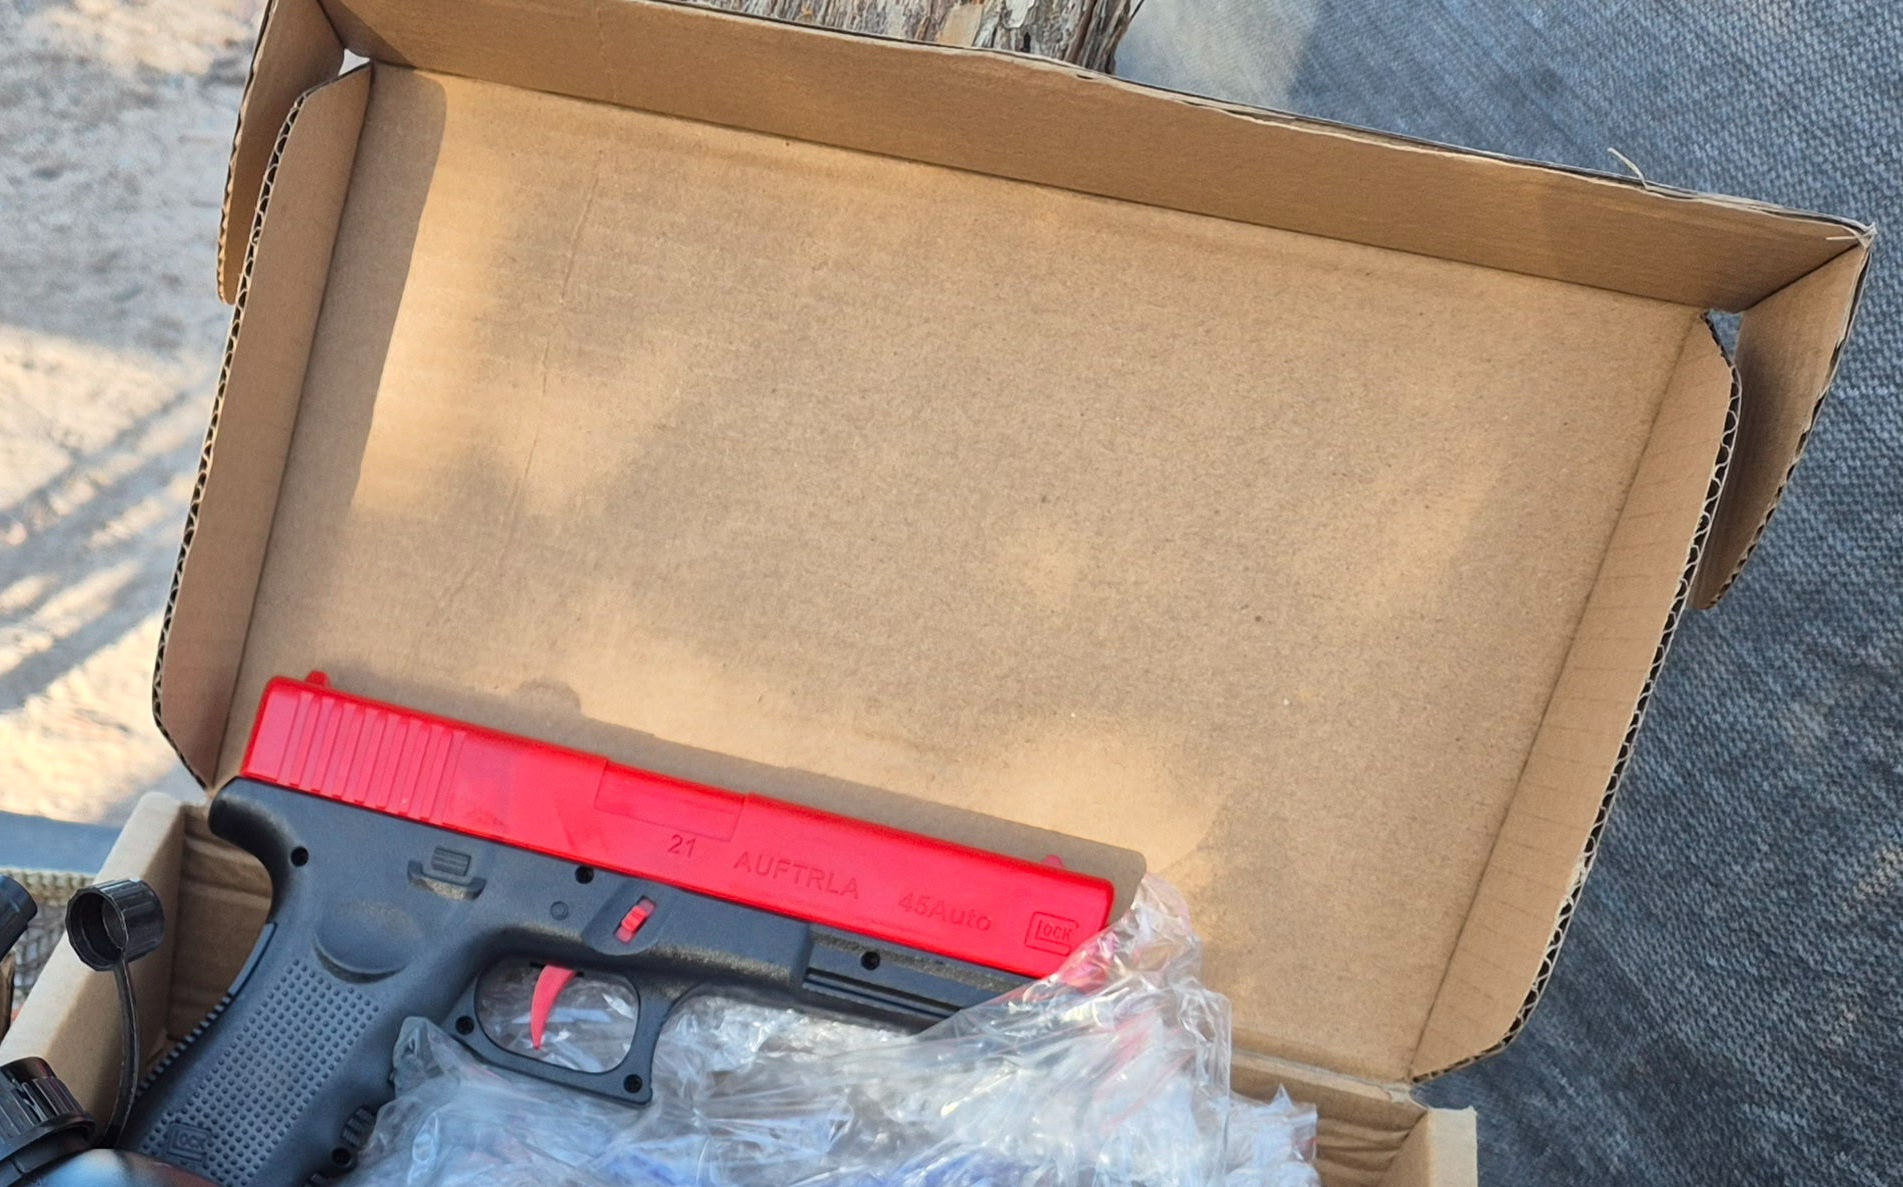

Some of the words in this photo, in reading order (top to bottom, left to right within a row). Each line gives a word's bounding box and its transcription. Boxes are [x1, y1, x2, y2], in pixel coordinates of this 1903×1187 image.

[667, 833, 697, 858] 21
[733, 850, 859, 899] AUFTRLA
[898, 891, 992, 932] 45Auto
